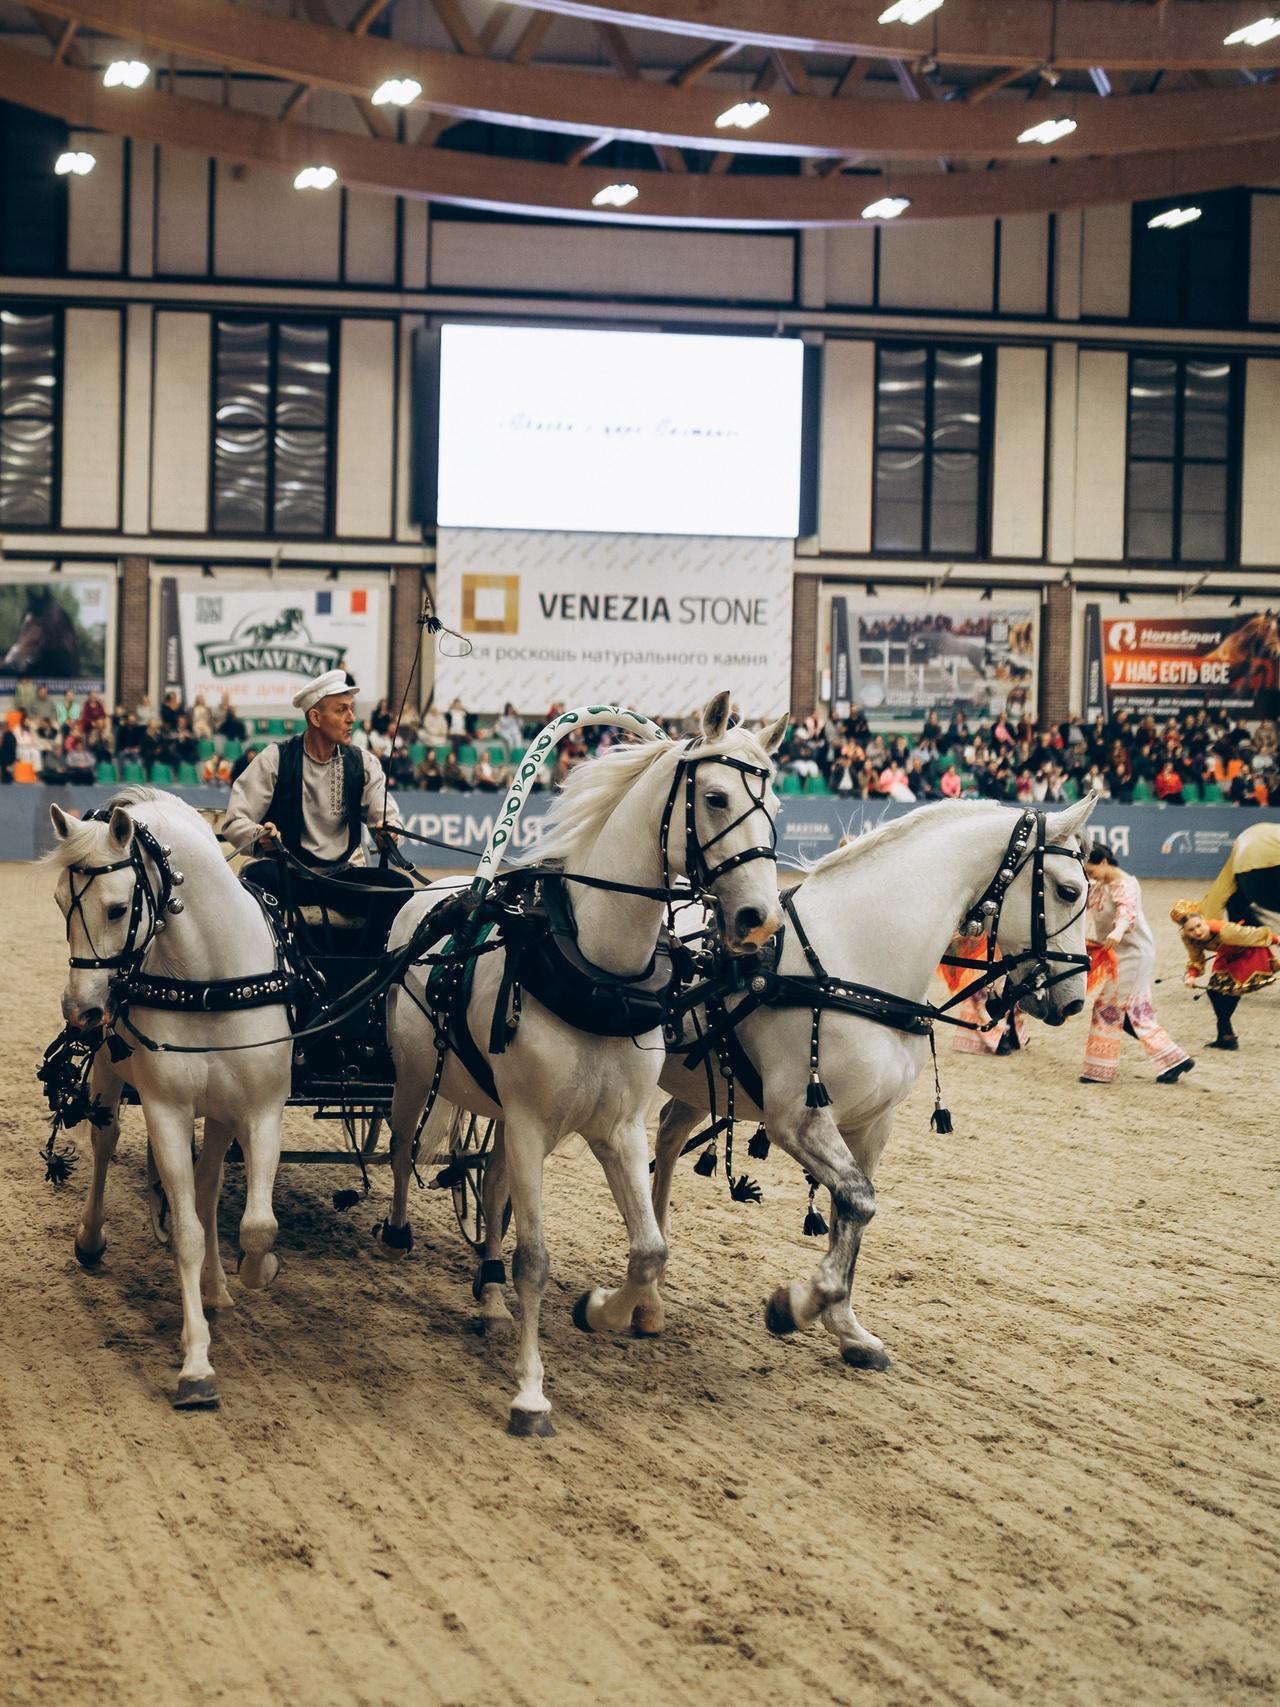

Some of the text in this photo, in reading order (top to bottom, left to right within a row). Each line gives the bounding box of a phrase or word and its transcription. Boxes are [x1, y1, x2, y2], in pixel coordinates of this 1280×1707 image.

[538, 592, 768, 626] VENEZIA STONE
[1141, 629, 1221, 645] HorseSmart
[214, 650, 329, 676] DYNAVENA
[496, 644, 577, 663] роскошь
[581, 647, 708, 667] натурального
[713, 651, 768, 667] камня
[1112, 660, 1231, 684] У НАС ЕСТЬ ВСЕ
